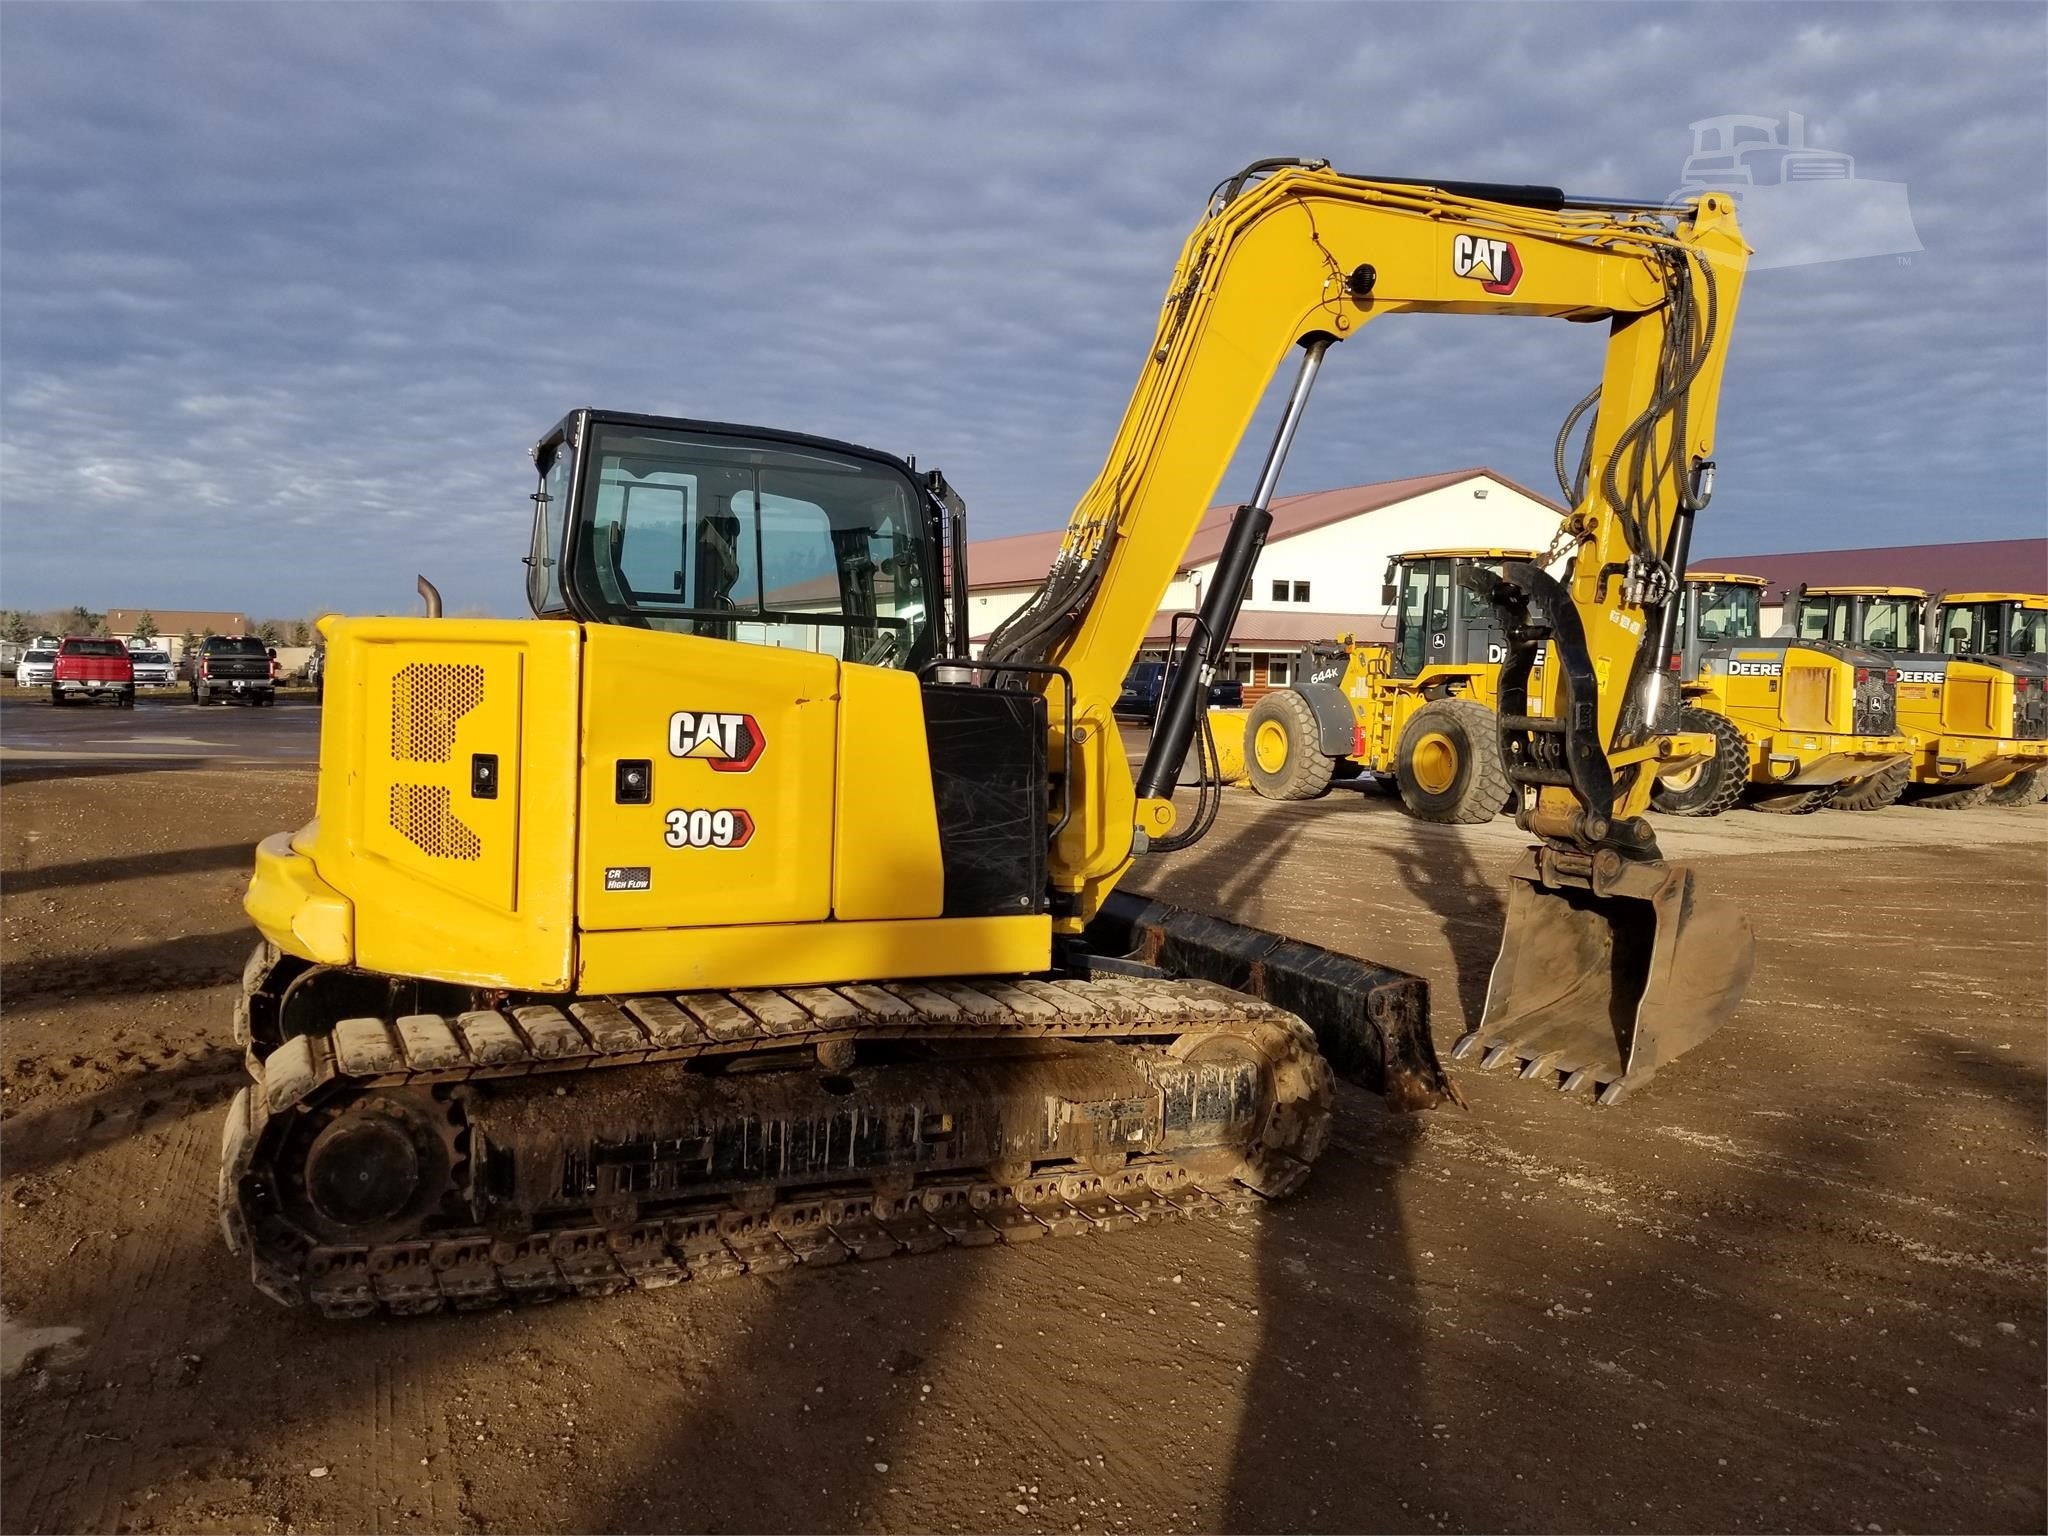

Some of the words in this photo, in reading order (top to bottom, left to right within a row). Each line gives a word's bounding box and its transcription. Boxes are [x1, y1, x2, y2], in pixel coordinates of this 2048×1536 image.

[1454, 234, 1508, 282] CAT
[1311, 668, 1339, 684] 644K
[1728, 661, 1782, 676] DEERE
[669, 711, 744, 759] CAT
[665, 809, 735, 847] 309
[608, 869, 621, 879] CR
